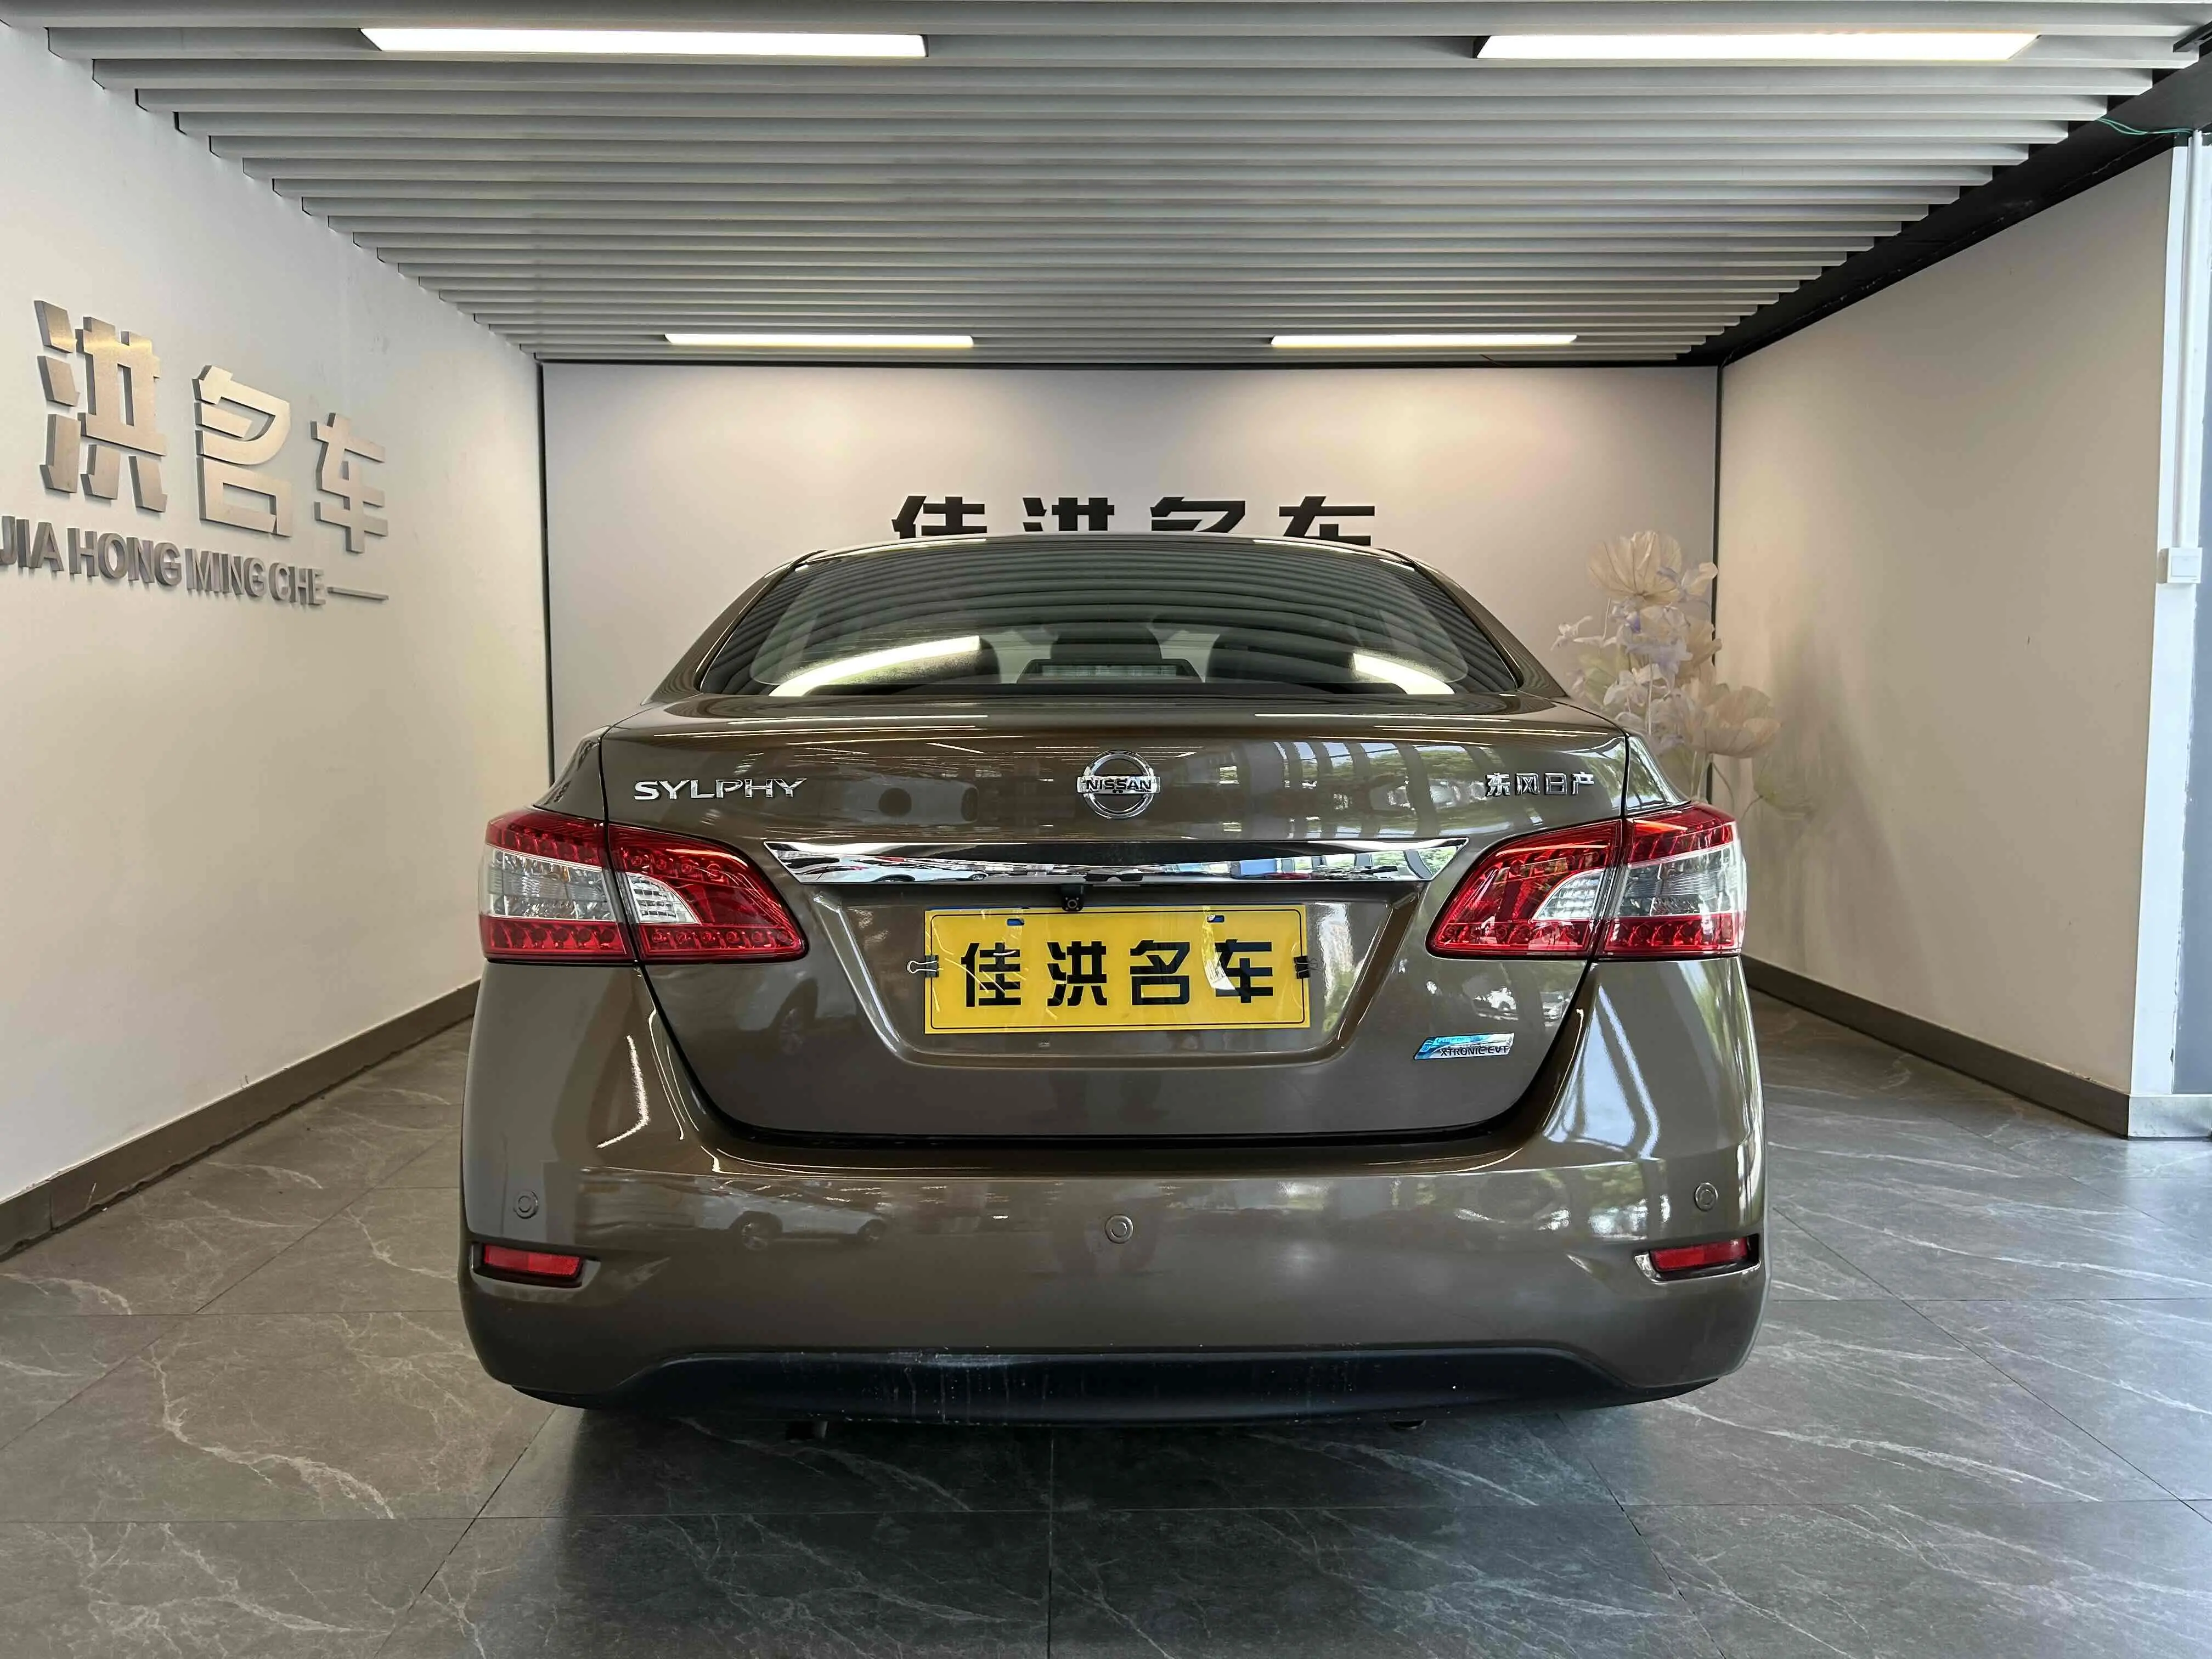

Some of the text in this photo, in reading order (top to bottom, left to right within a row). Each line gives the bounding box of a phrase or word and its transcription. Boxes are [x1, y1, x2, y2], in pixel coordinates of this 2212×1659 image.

[34, 300, 388, 554] 洪名车
[0, 516, 326, 605] JIA HONG MING CHE
[634, 778, 808, 800] SYLPHY
[1085, 778, 1152, 790] NISSAN
[1486, 772, 1594, 797] 东风日产
[961, 939, 1273, 1007] 佳洪名车
[1440, 1045, 1510, 1057] XTRONIC CVT
